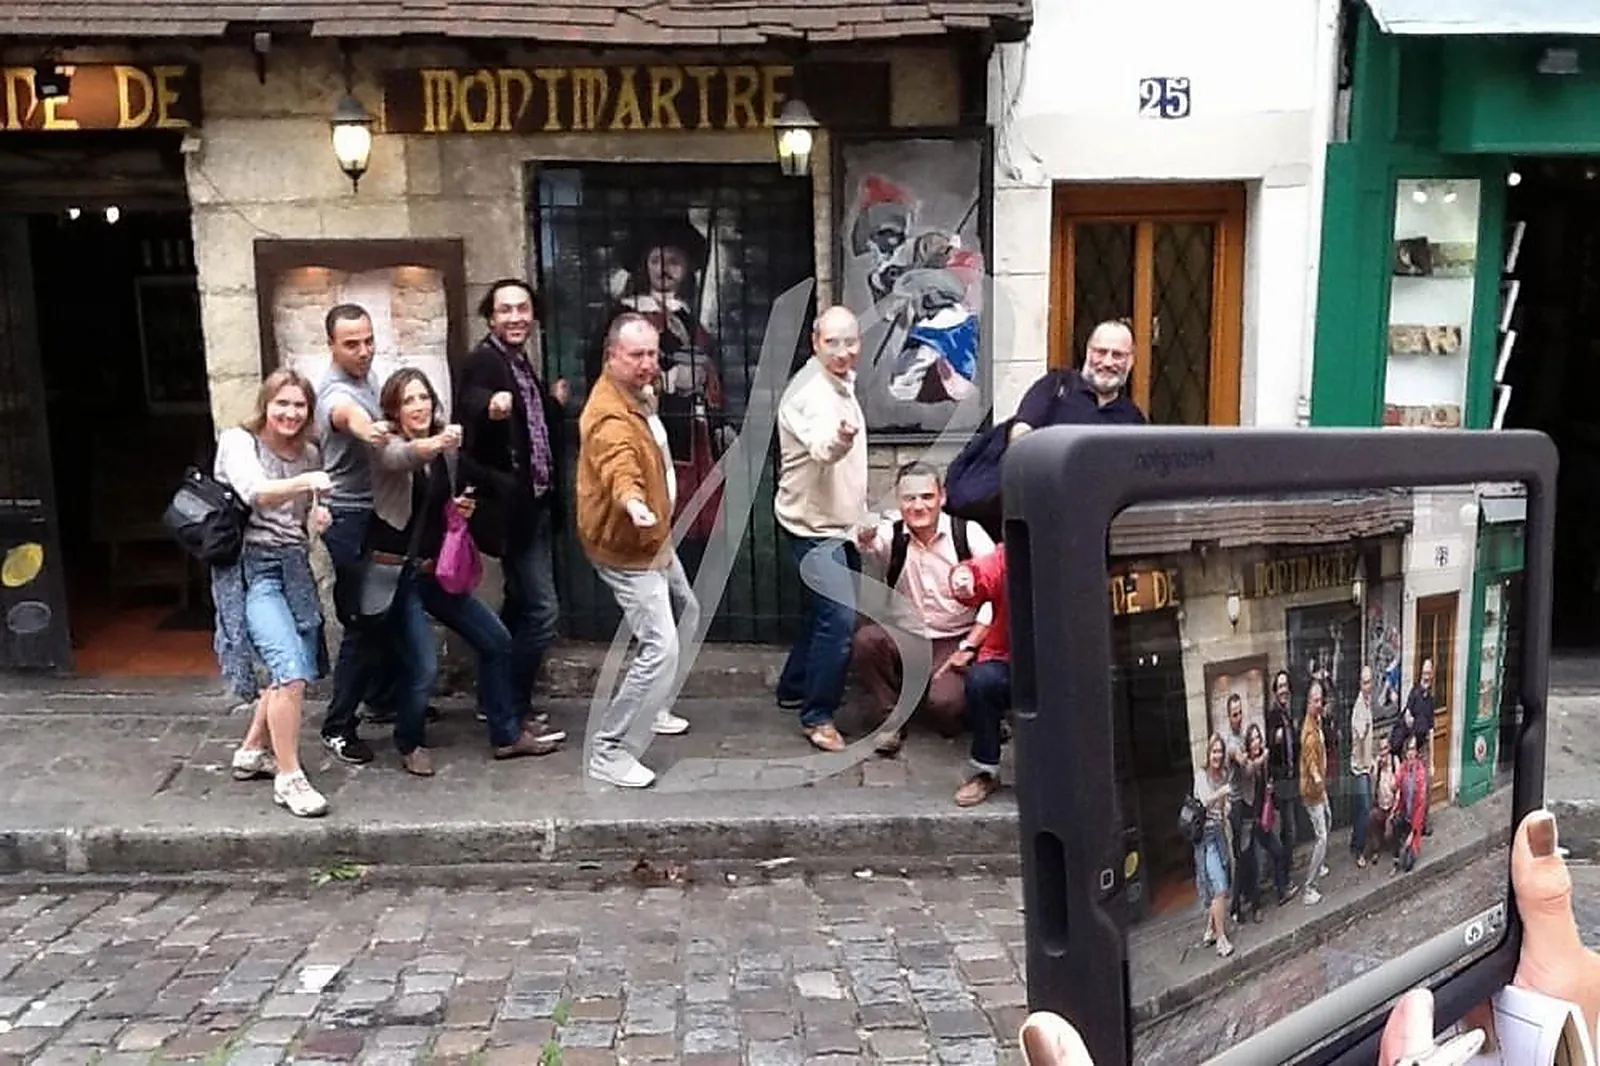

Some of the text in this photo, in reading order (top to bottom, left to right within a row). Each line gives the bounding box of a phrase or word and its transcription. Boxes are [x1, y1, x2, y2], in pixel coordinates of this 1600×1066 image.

[0, 65, 794, 132] NE DE MONTMARTRE
[1139, 78, 1190, 118] 25
